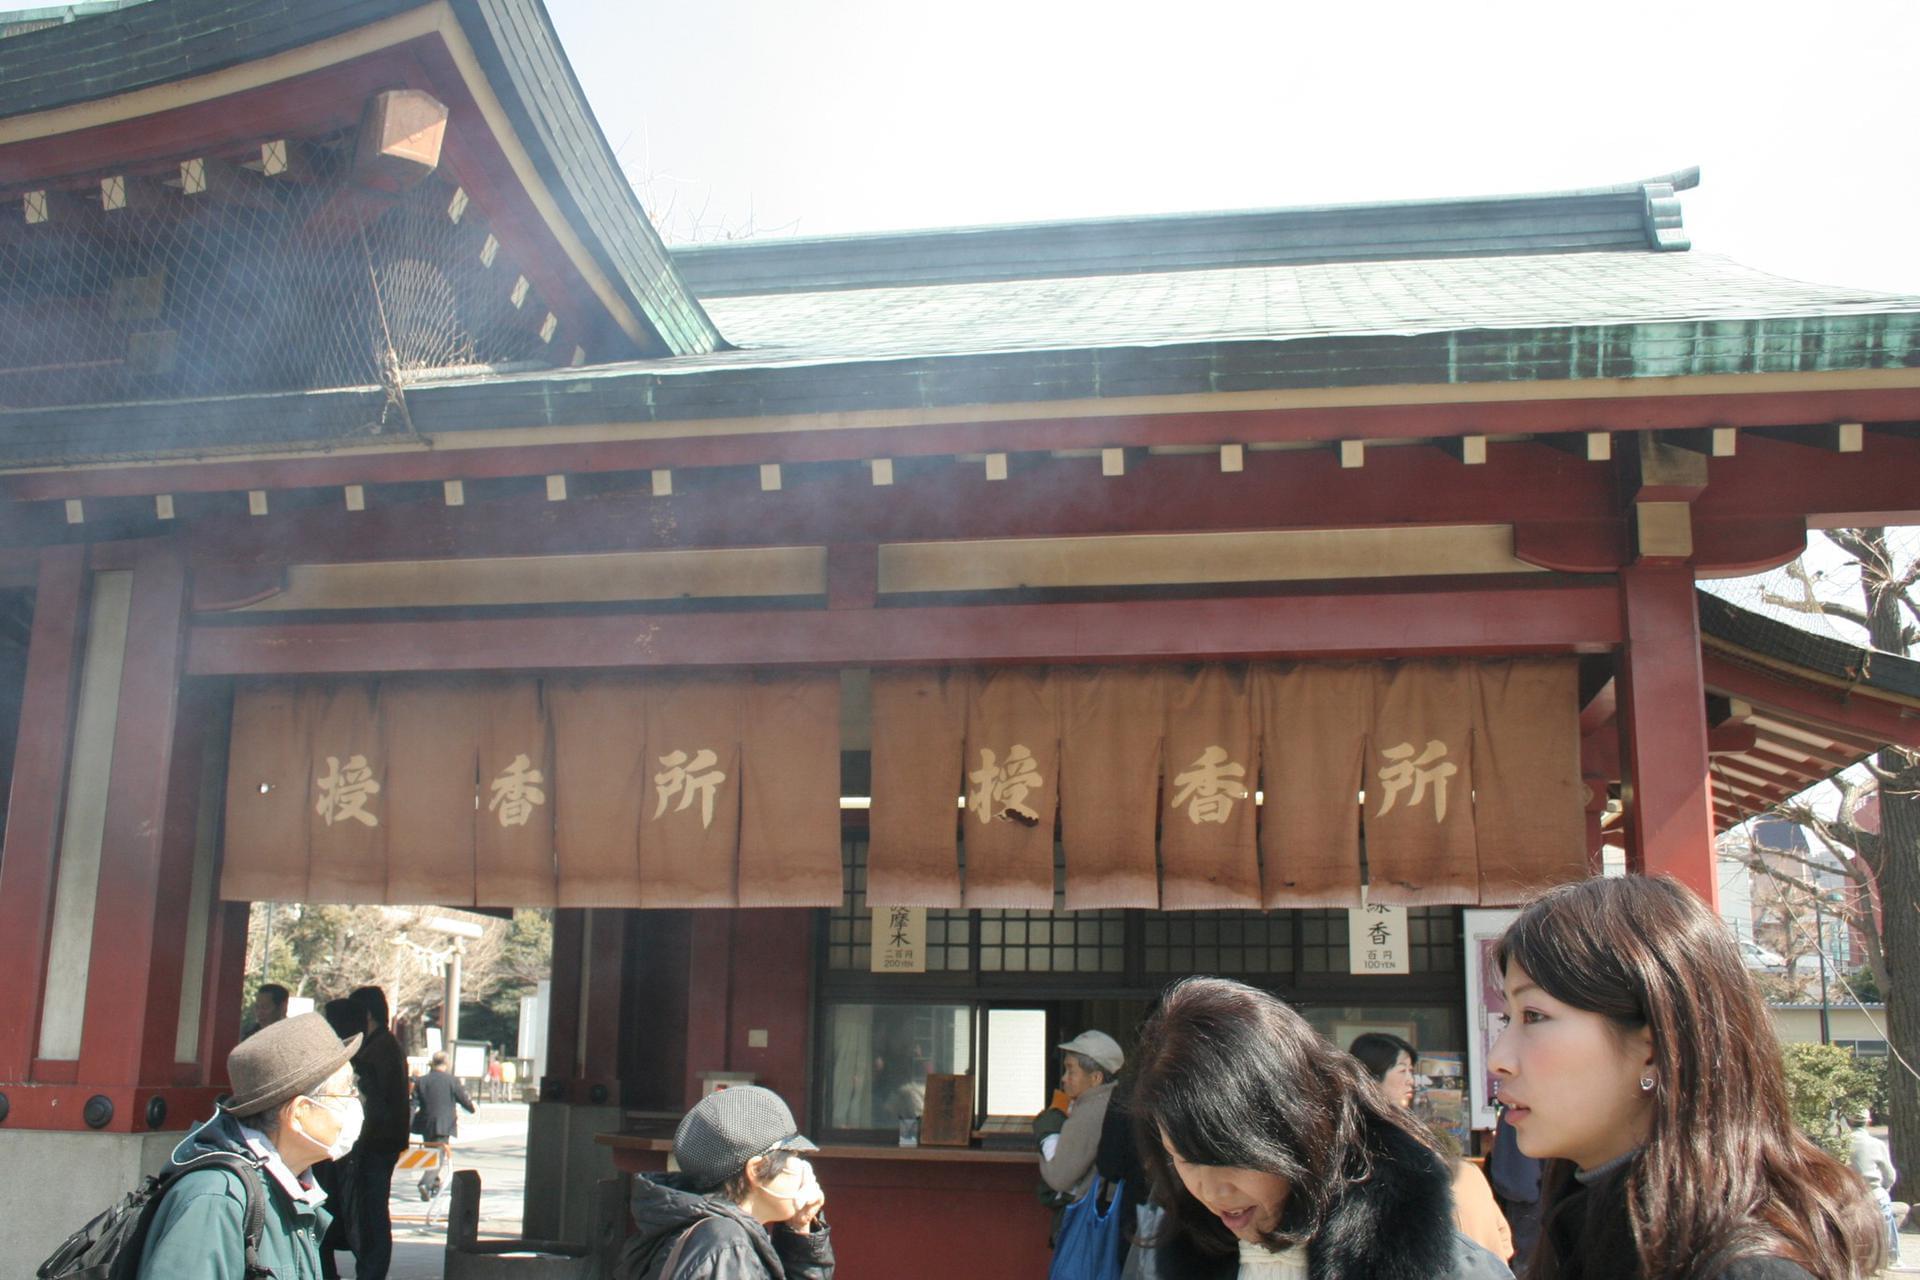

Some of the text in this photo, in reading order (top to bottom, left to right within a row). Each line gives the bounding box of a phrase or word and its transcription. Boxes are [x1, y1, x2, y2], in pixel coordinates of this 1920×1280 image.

[316, 748, 727, 829] 授香所
[968, 738, 1458, 828] 授香所
[1364, 960, 1396, 969] 100YEN
[1366, 949, 1393, 960] 百円
